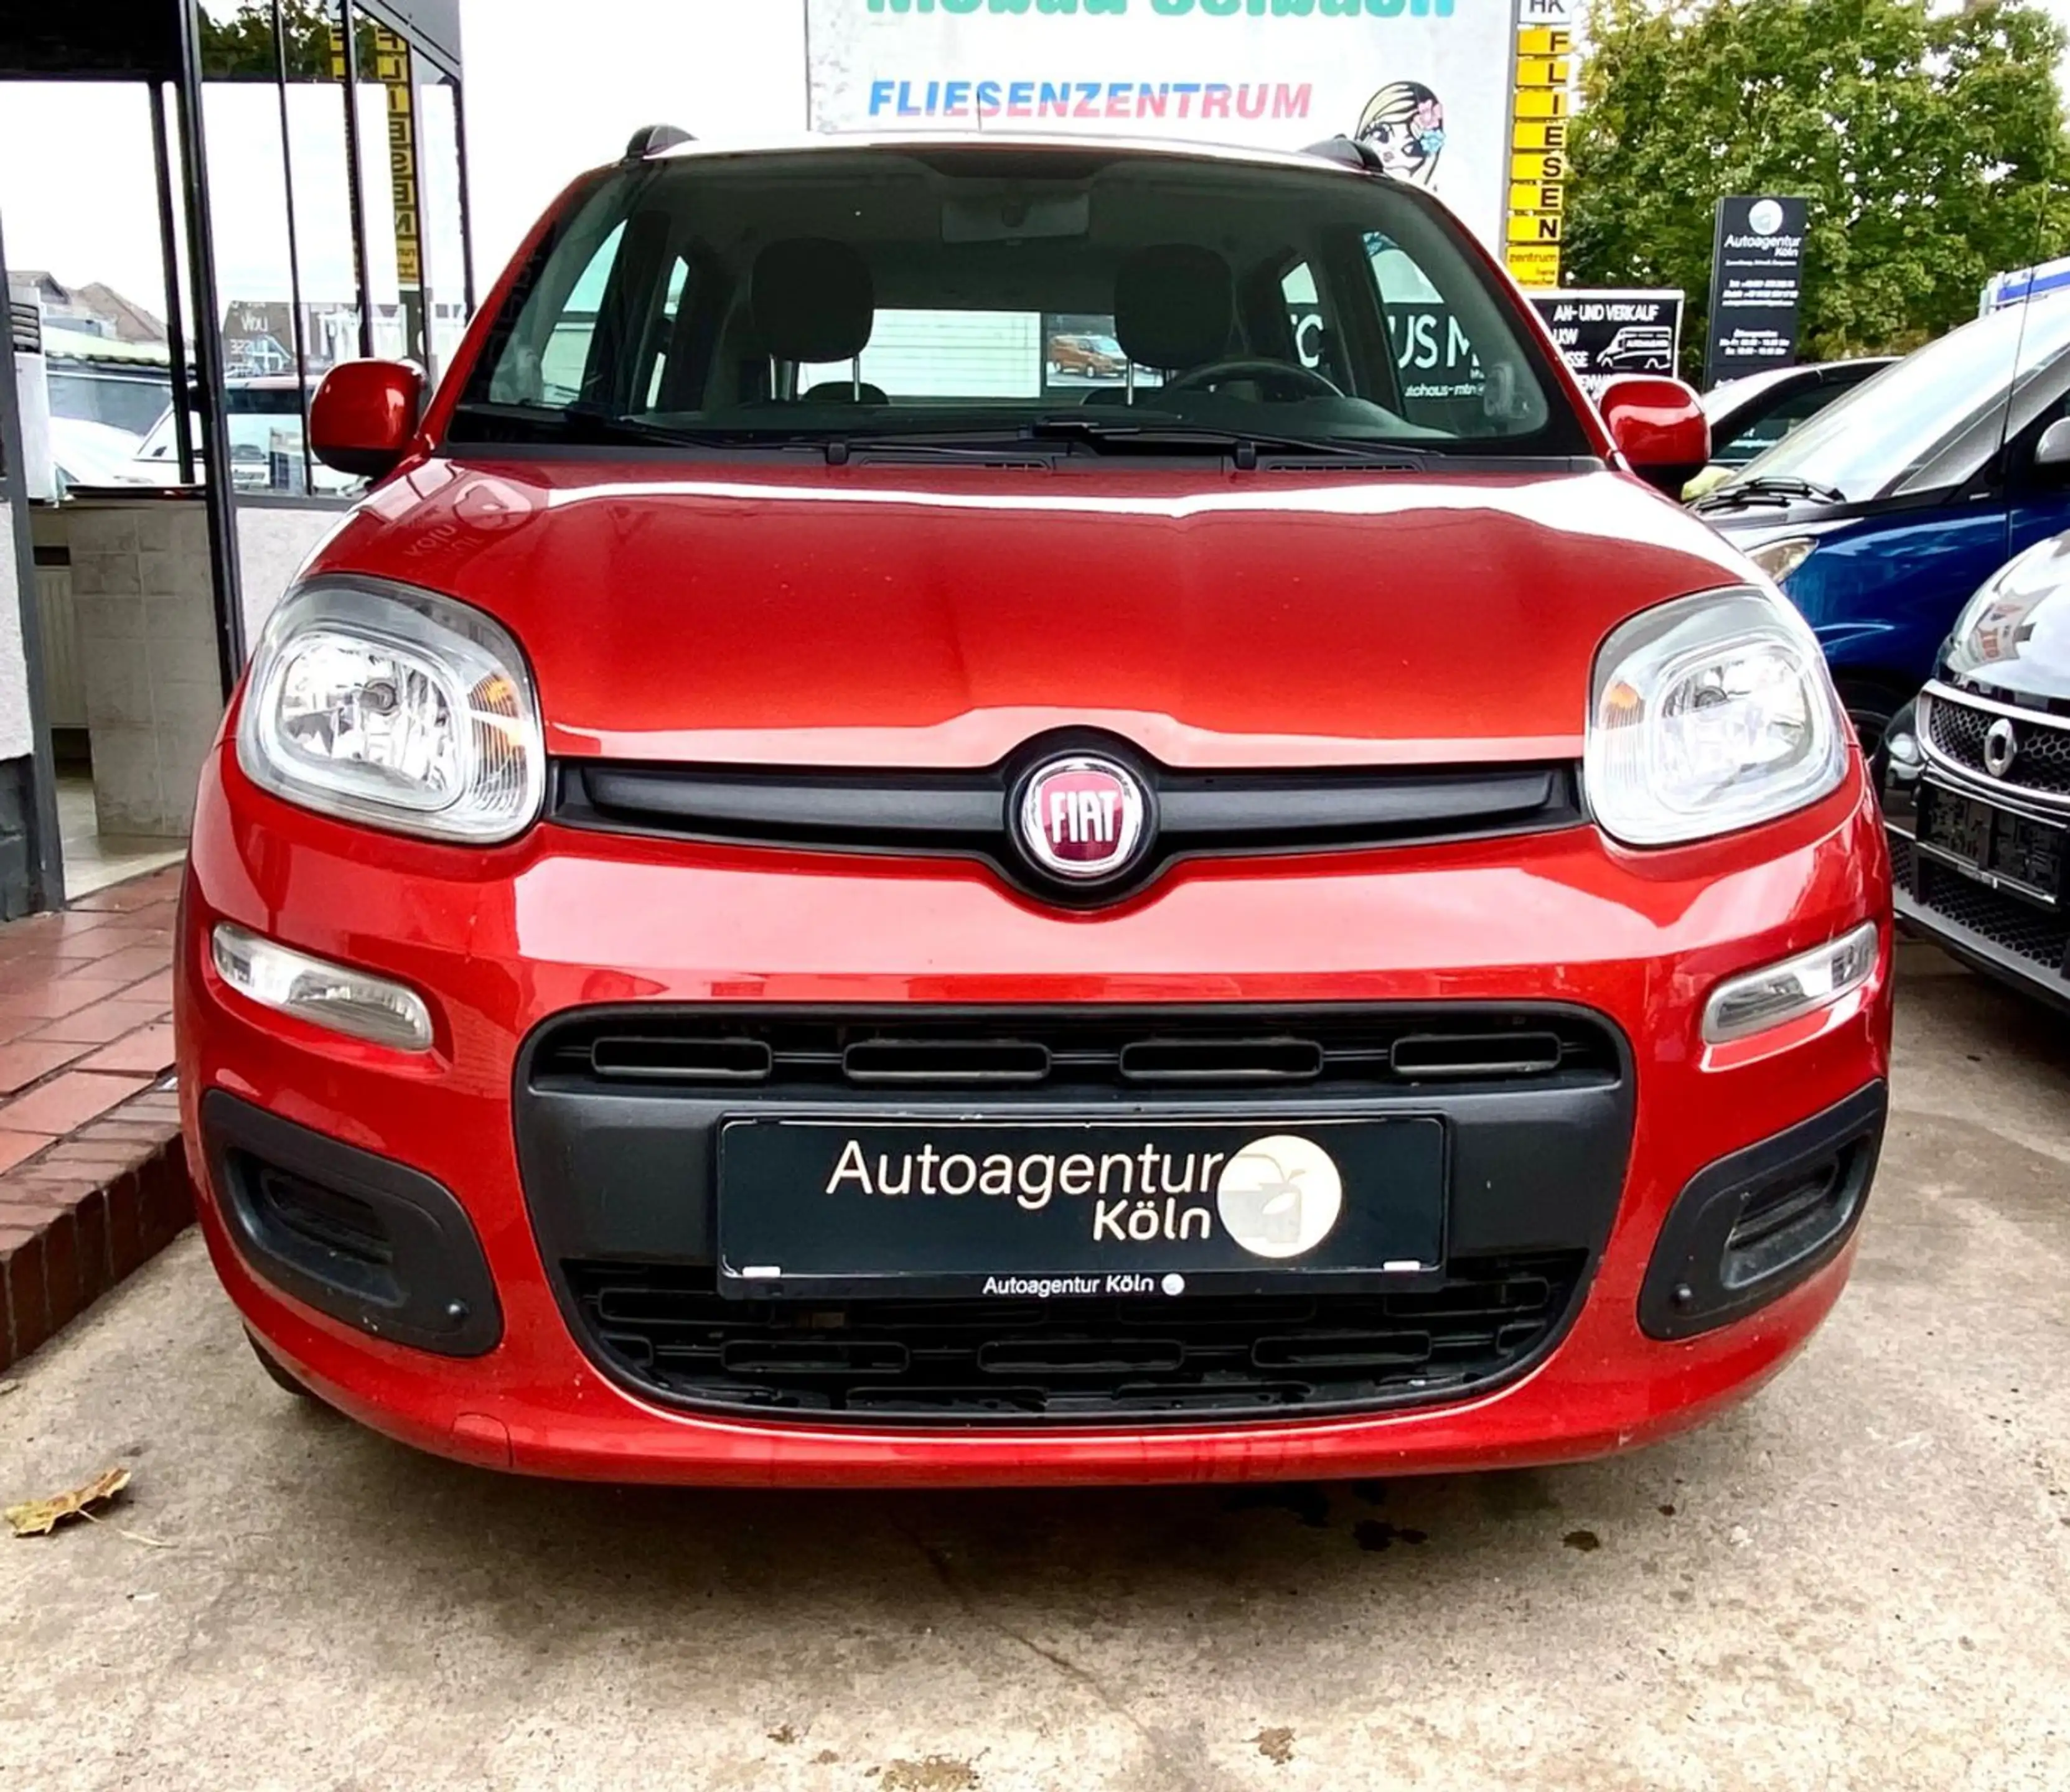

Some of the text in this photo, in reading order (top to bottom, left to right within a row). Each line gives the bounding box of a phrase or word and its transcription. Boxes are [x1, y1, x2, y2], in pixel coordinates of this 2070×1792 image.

[868, 80, 1313, 119] FLIESENZENTRUM
[1538, 31, 1570, 238] FLIESEN
[1723, 234, 1802, 251] Autoagentur
[1579, 304, 1604, 321] UND
[1605, 304, 1659, 321] VERKAUF
[1050, 789, 1118, 843] FIAT
[825, 1139, 1224, 1210] Autoagentur
[1092, 1197, 1212, 1241] Köln
[982, 1274, 1154, 1297] Autoagentur Köln
